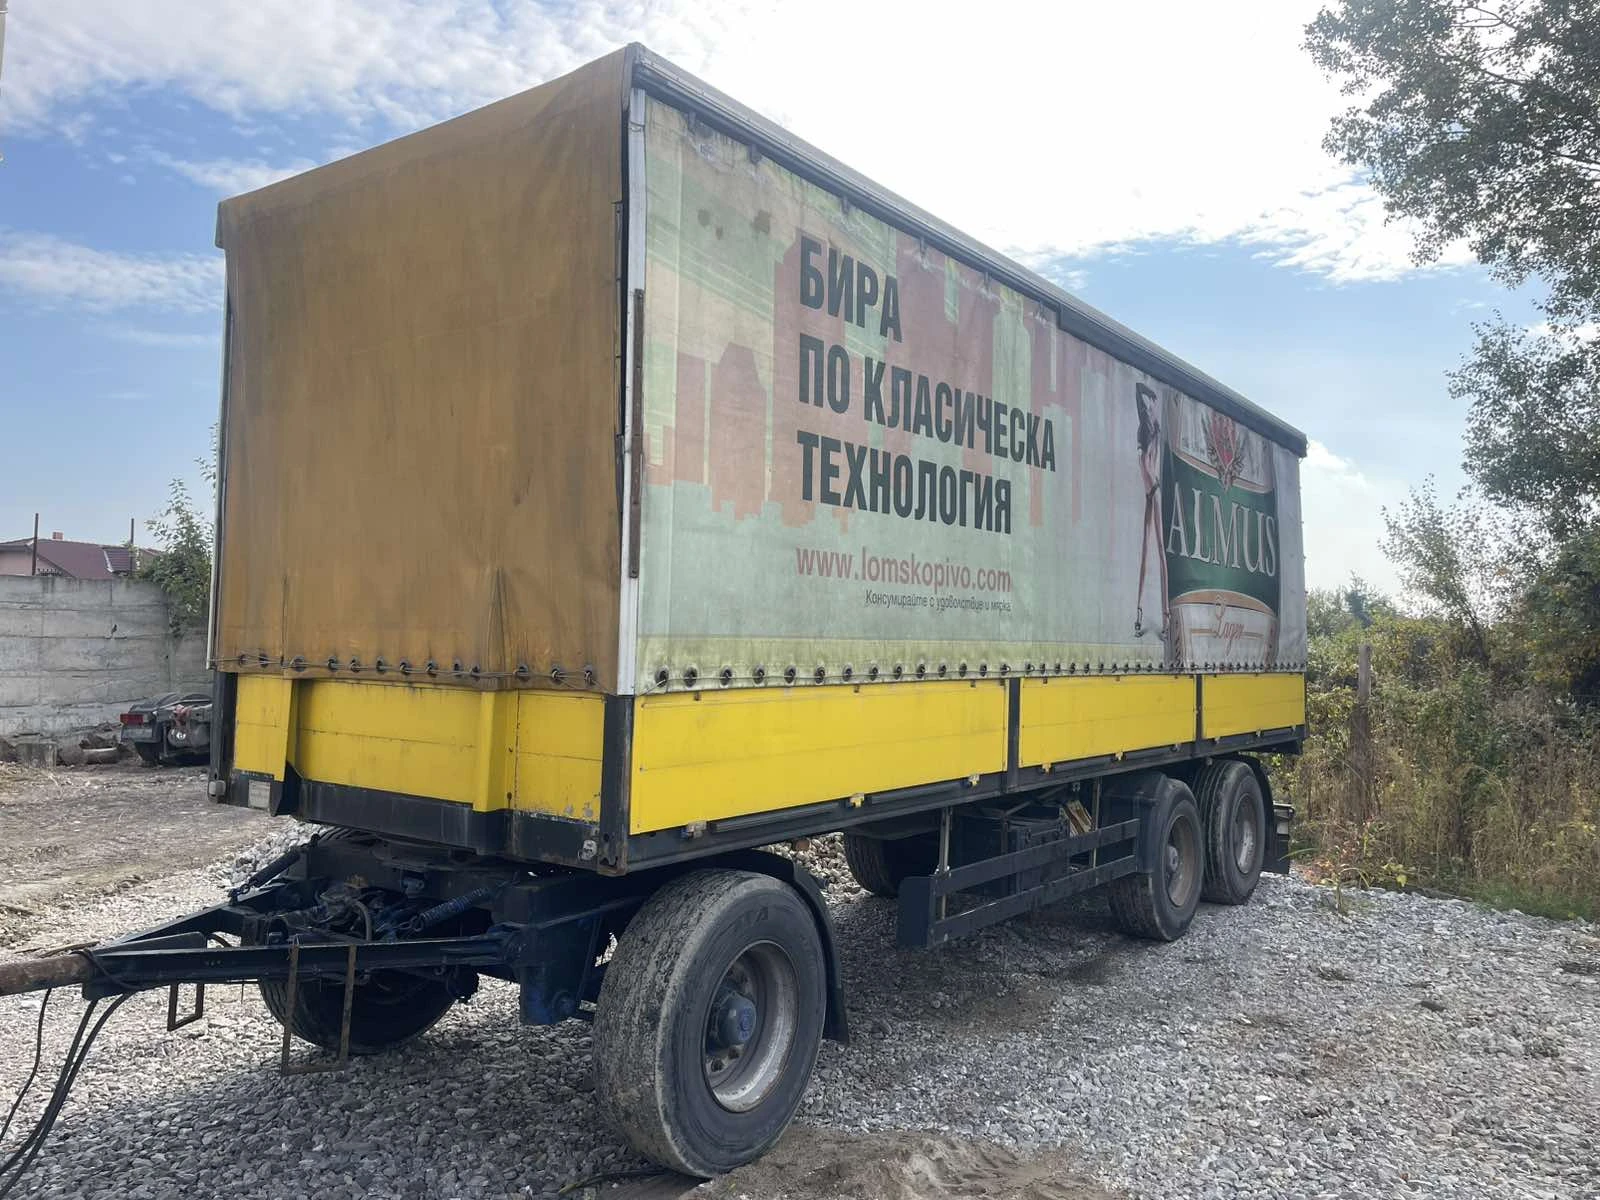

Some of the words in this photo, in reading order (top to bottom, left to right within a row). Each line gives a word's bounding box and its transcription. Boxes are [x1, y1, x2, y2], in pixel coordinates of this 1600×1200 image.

[800, 235, 902, 343] БИРА
[799, 332, 850, 414] ПО
[864, 356, 1056, 472] КЛАСИЧЕСКА
[797, 430, 1011, 535] ТЕХНОЛОГИЯ
[1166, 482, 1276, 577] ALMUS
[796, 547, 1011, 594] www.lomskopivo.com
[864, 589, 927, 608] Консумирайте
